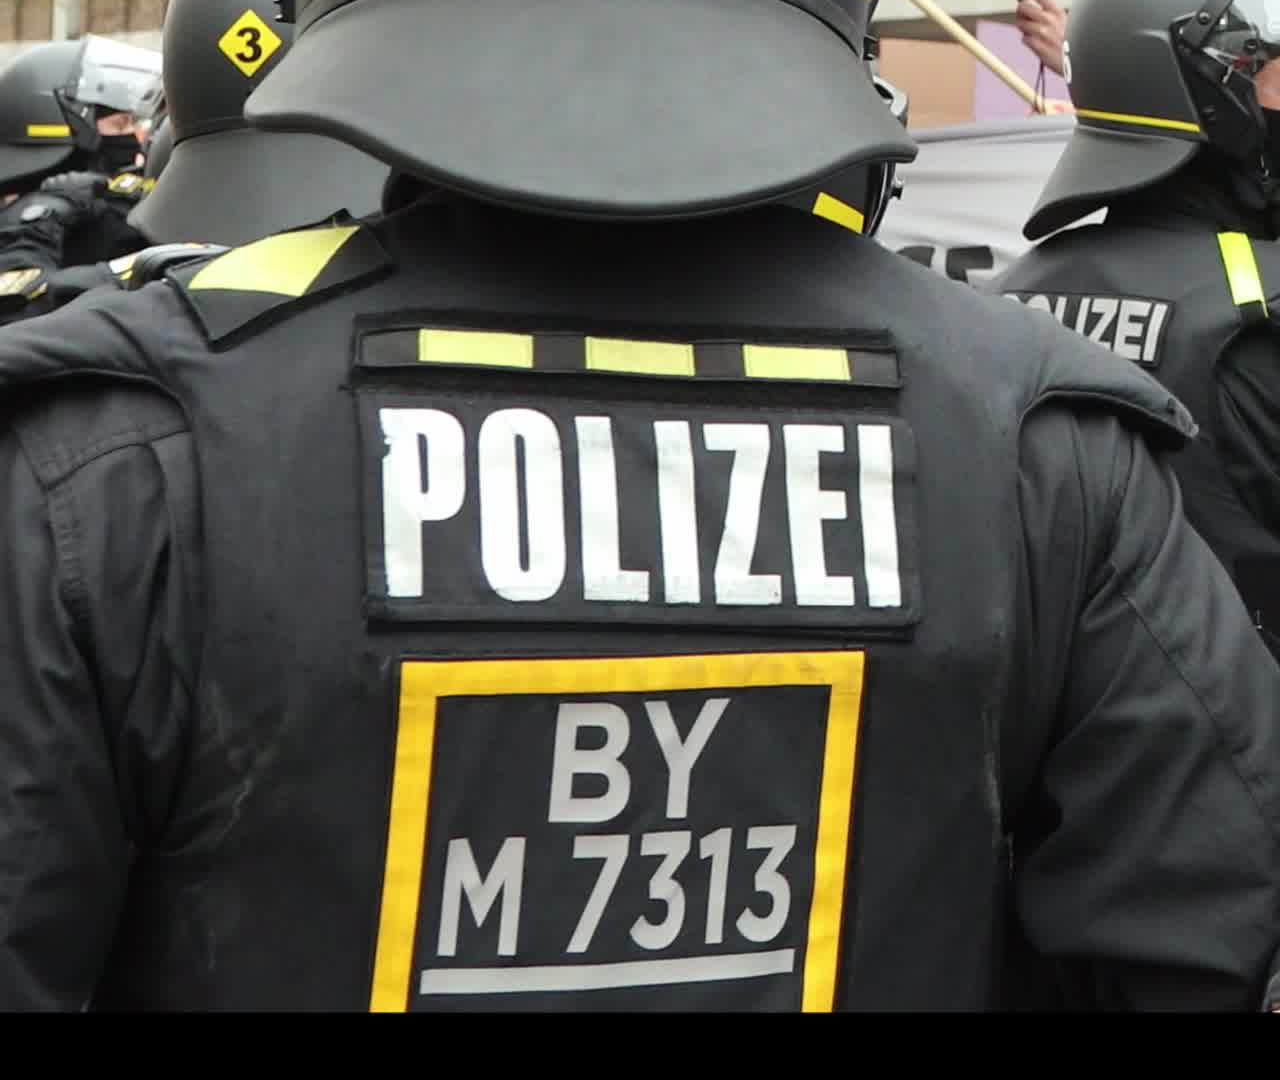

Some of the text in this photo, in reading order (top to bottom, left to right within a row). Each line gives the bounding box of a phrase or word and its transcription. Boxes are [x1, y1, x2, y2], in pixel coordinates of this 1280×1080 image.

[236, 27, 263, 63] 3
[379, 407, 901, 607] POLIZEI
[548, 698, 731, 823] BY
[437, 824, 797, 957] M 7313
